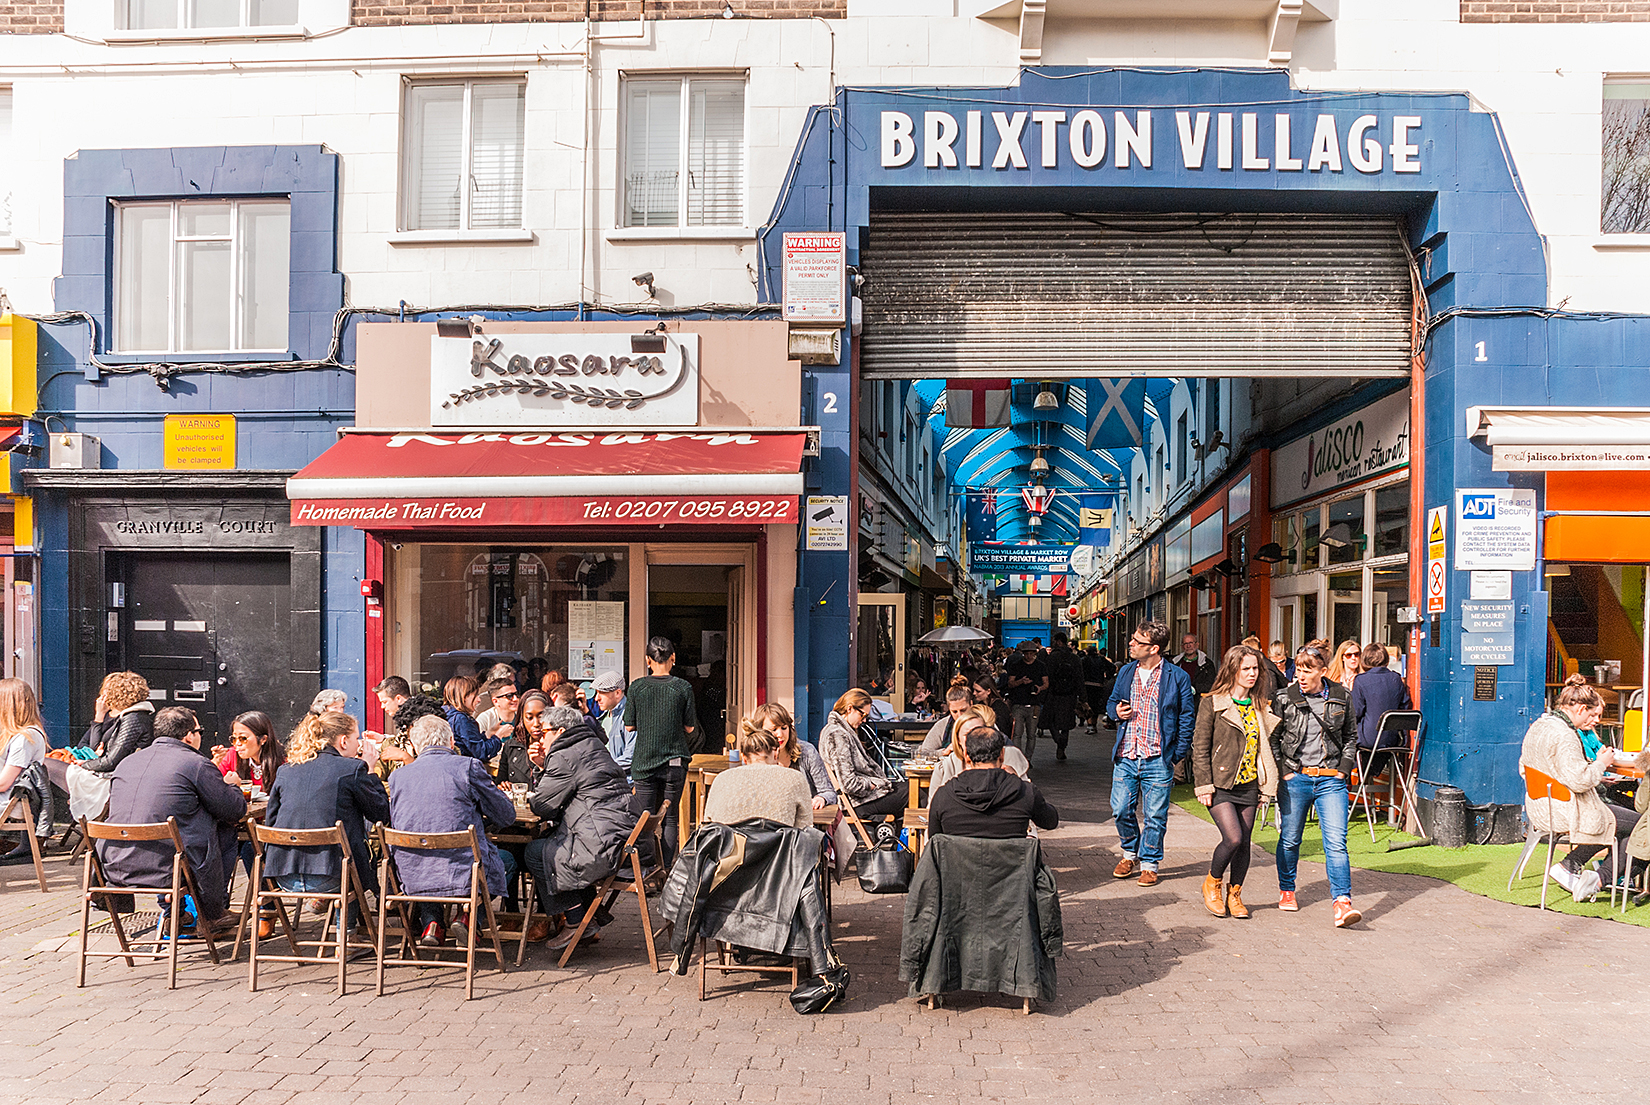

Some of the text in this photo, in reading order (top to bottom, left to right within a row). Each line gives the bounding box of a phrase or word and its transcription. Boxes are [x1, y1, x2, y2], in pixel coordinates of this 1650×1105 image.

[880, 110, 1422, 173] BRIXTON VILLAGE
[786, 238, 840, 248] WARNING
[470, 338, 666, 378] Kaosarn
[1474, 340, 1488, 362] 1
[824, 392, 838, 414] 2
[179, 420, 220, 428] WARNING
[1302, 420, 1364, 490] Jalisco
[1527, 452, 1644, 462] jalisco.brixton@live.com
[297, 502, 486, 520] Homemade Thai Food
[583, 500, 790, 518] Tel: 0207 095 8922
[1462, 498, 1495, 516] ADT
[1516, 498, 1531, 506] and
[1498, 507, 1531, 517] Security
[117, 520, 276, 533] GRANVILLE COURT
